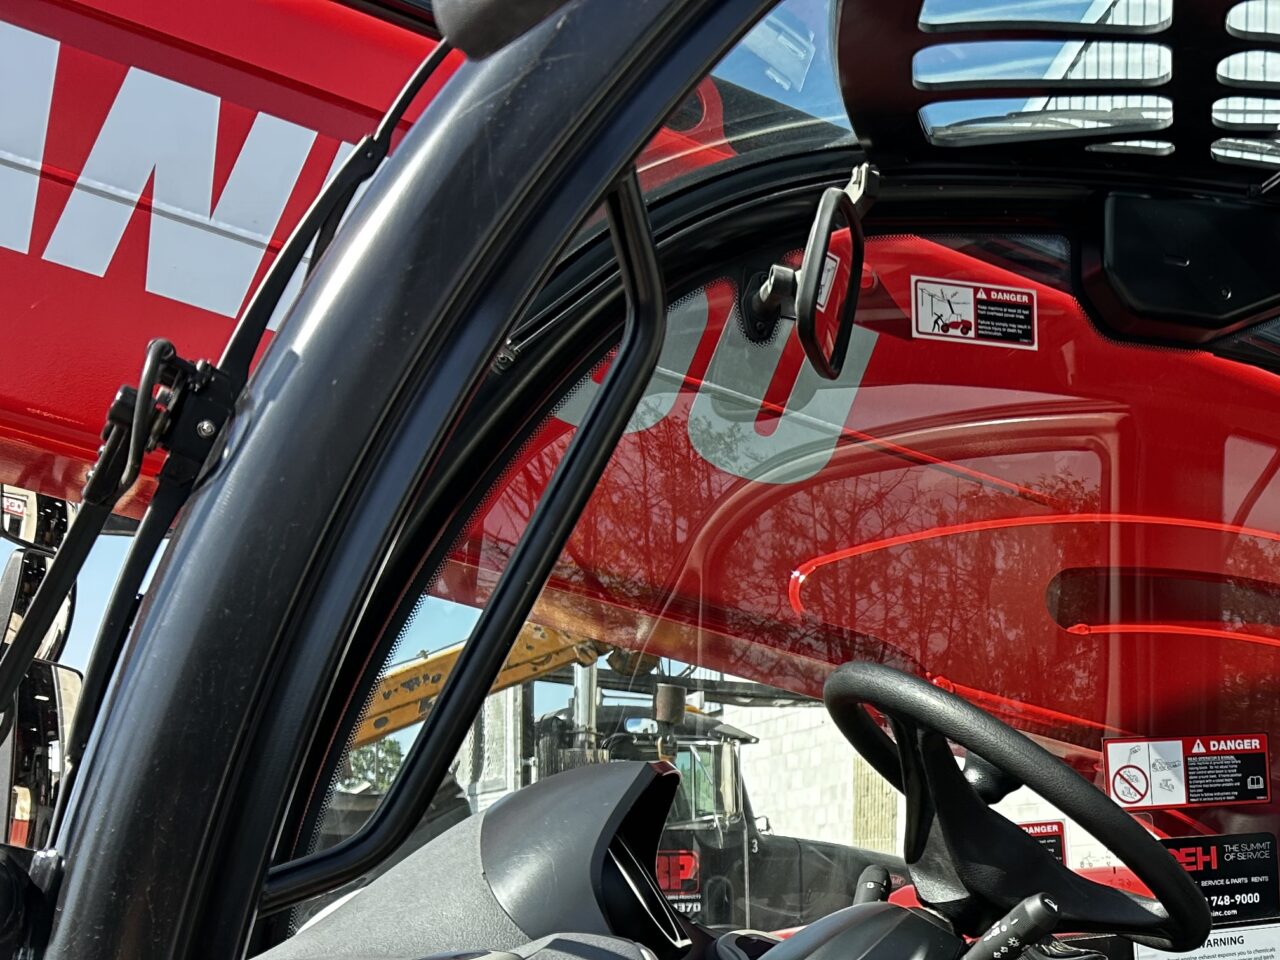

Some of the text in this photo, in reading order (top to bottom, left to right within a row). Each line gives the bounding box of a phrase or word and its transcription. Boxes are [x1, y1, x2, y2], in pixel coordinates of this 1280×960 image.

[991, 291, 1029, 303] DANGER
[1210, 739, 1260, 751] DANGER
[752, 839, 758, 853] 3
[1224, 842, 1271, 853] THE SUMMIT
[1224, 851, 1270, 861] OF SERVICE
[1201, 879, 1224, 887] SERVICE
[1231, 877, 1248, 885] PARTS
[1212, 893, 1260, 906] 748-9000
